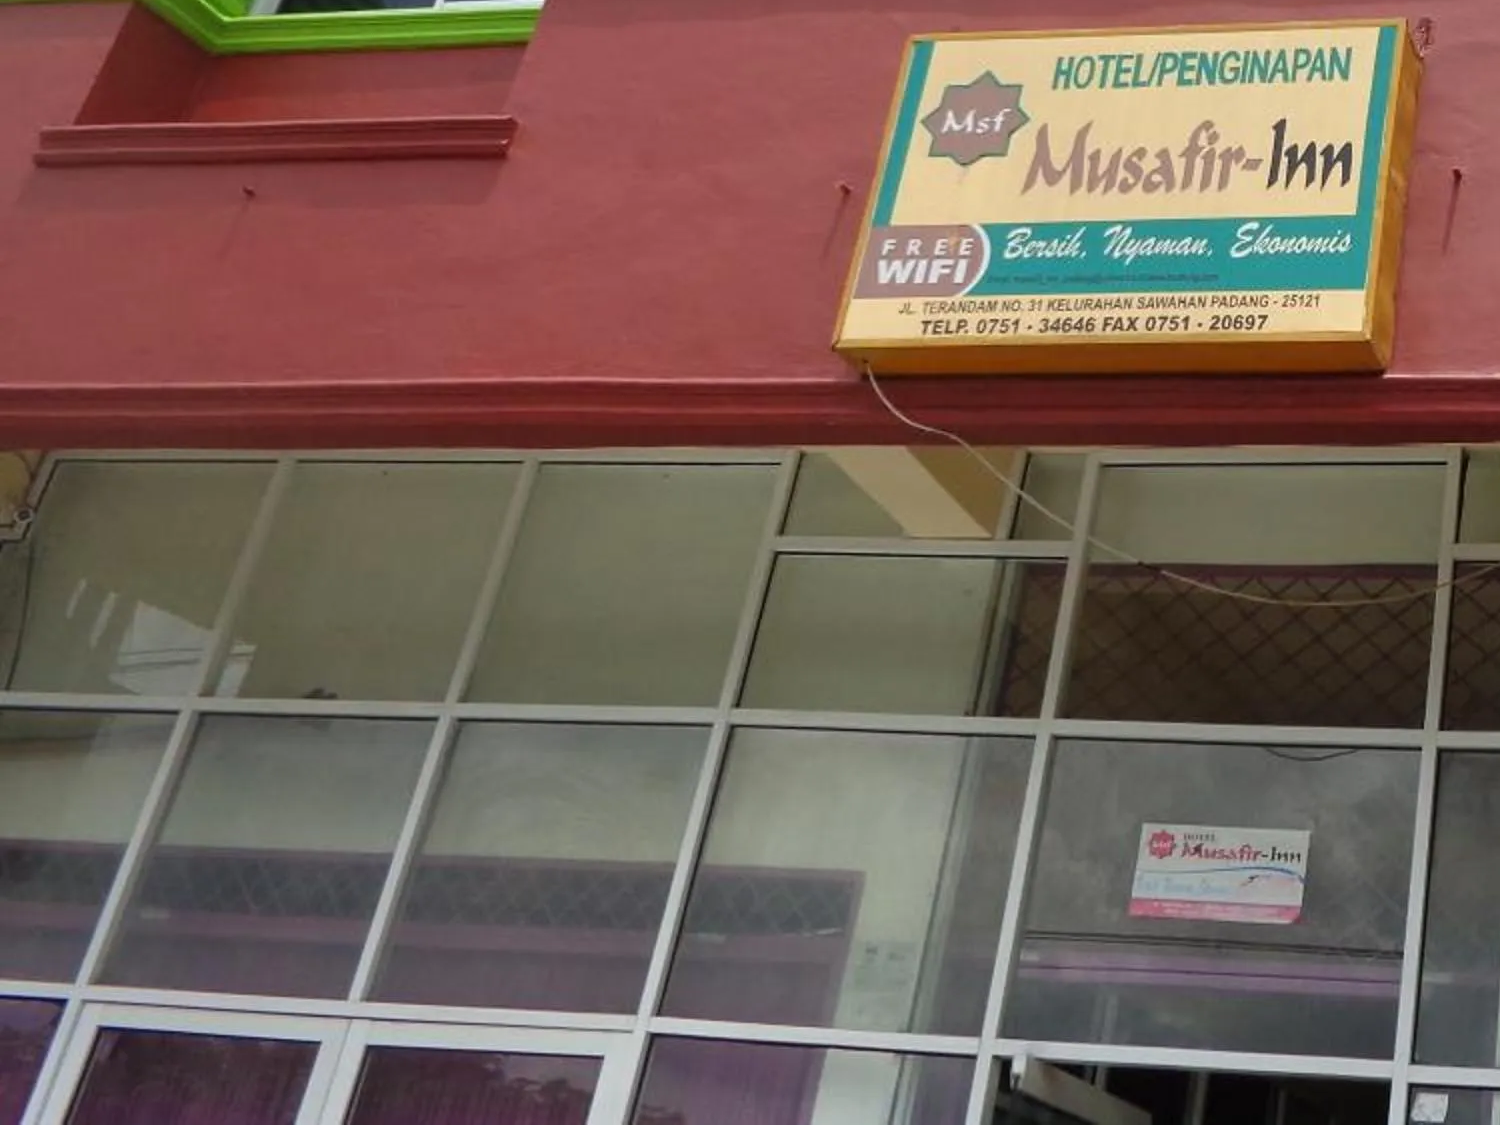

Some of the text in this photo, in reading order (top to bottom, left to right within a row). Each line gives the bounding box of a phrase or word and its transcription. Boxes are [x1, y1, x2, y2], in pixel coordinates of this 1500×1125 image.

[1051, 47, 1353, 91] HOTEL/PENGINAPAN
[939, 107, 1013, 136] Msf
[1020, 117, 1354, 197] Musafir-Inn
[880, 237, 974, 257] FREE
[1003, 221, 1353, 265] Bersih, Nyaman, Ekonomis
[876, 258, 969, 285] WIFI
[922, 300, 999, 315] TERANDAM
[1028, 300, 1042, 312] 31
[1047, 297, 1132, 312] KELURAHAN
[1136, 295, 1206, 310] SAWAHAN
[1210, 294, 1269, 308] PADANG
[1281, 294, 1321, 308] 25121
[920, 319, 968, 335] TELP.
[975, 318, 1020, 335] 0751
[1038, 317, 1096, 334] 34646
[1102, 316, 1140, 332] FAX
[1145, 315, 1191, 332] 0751
[1209, 314, 1269, 331] 20697
[1181, 841, 1302, 864] Musafir-Inn
